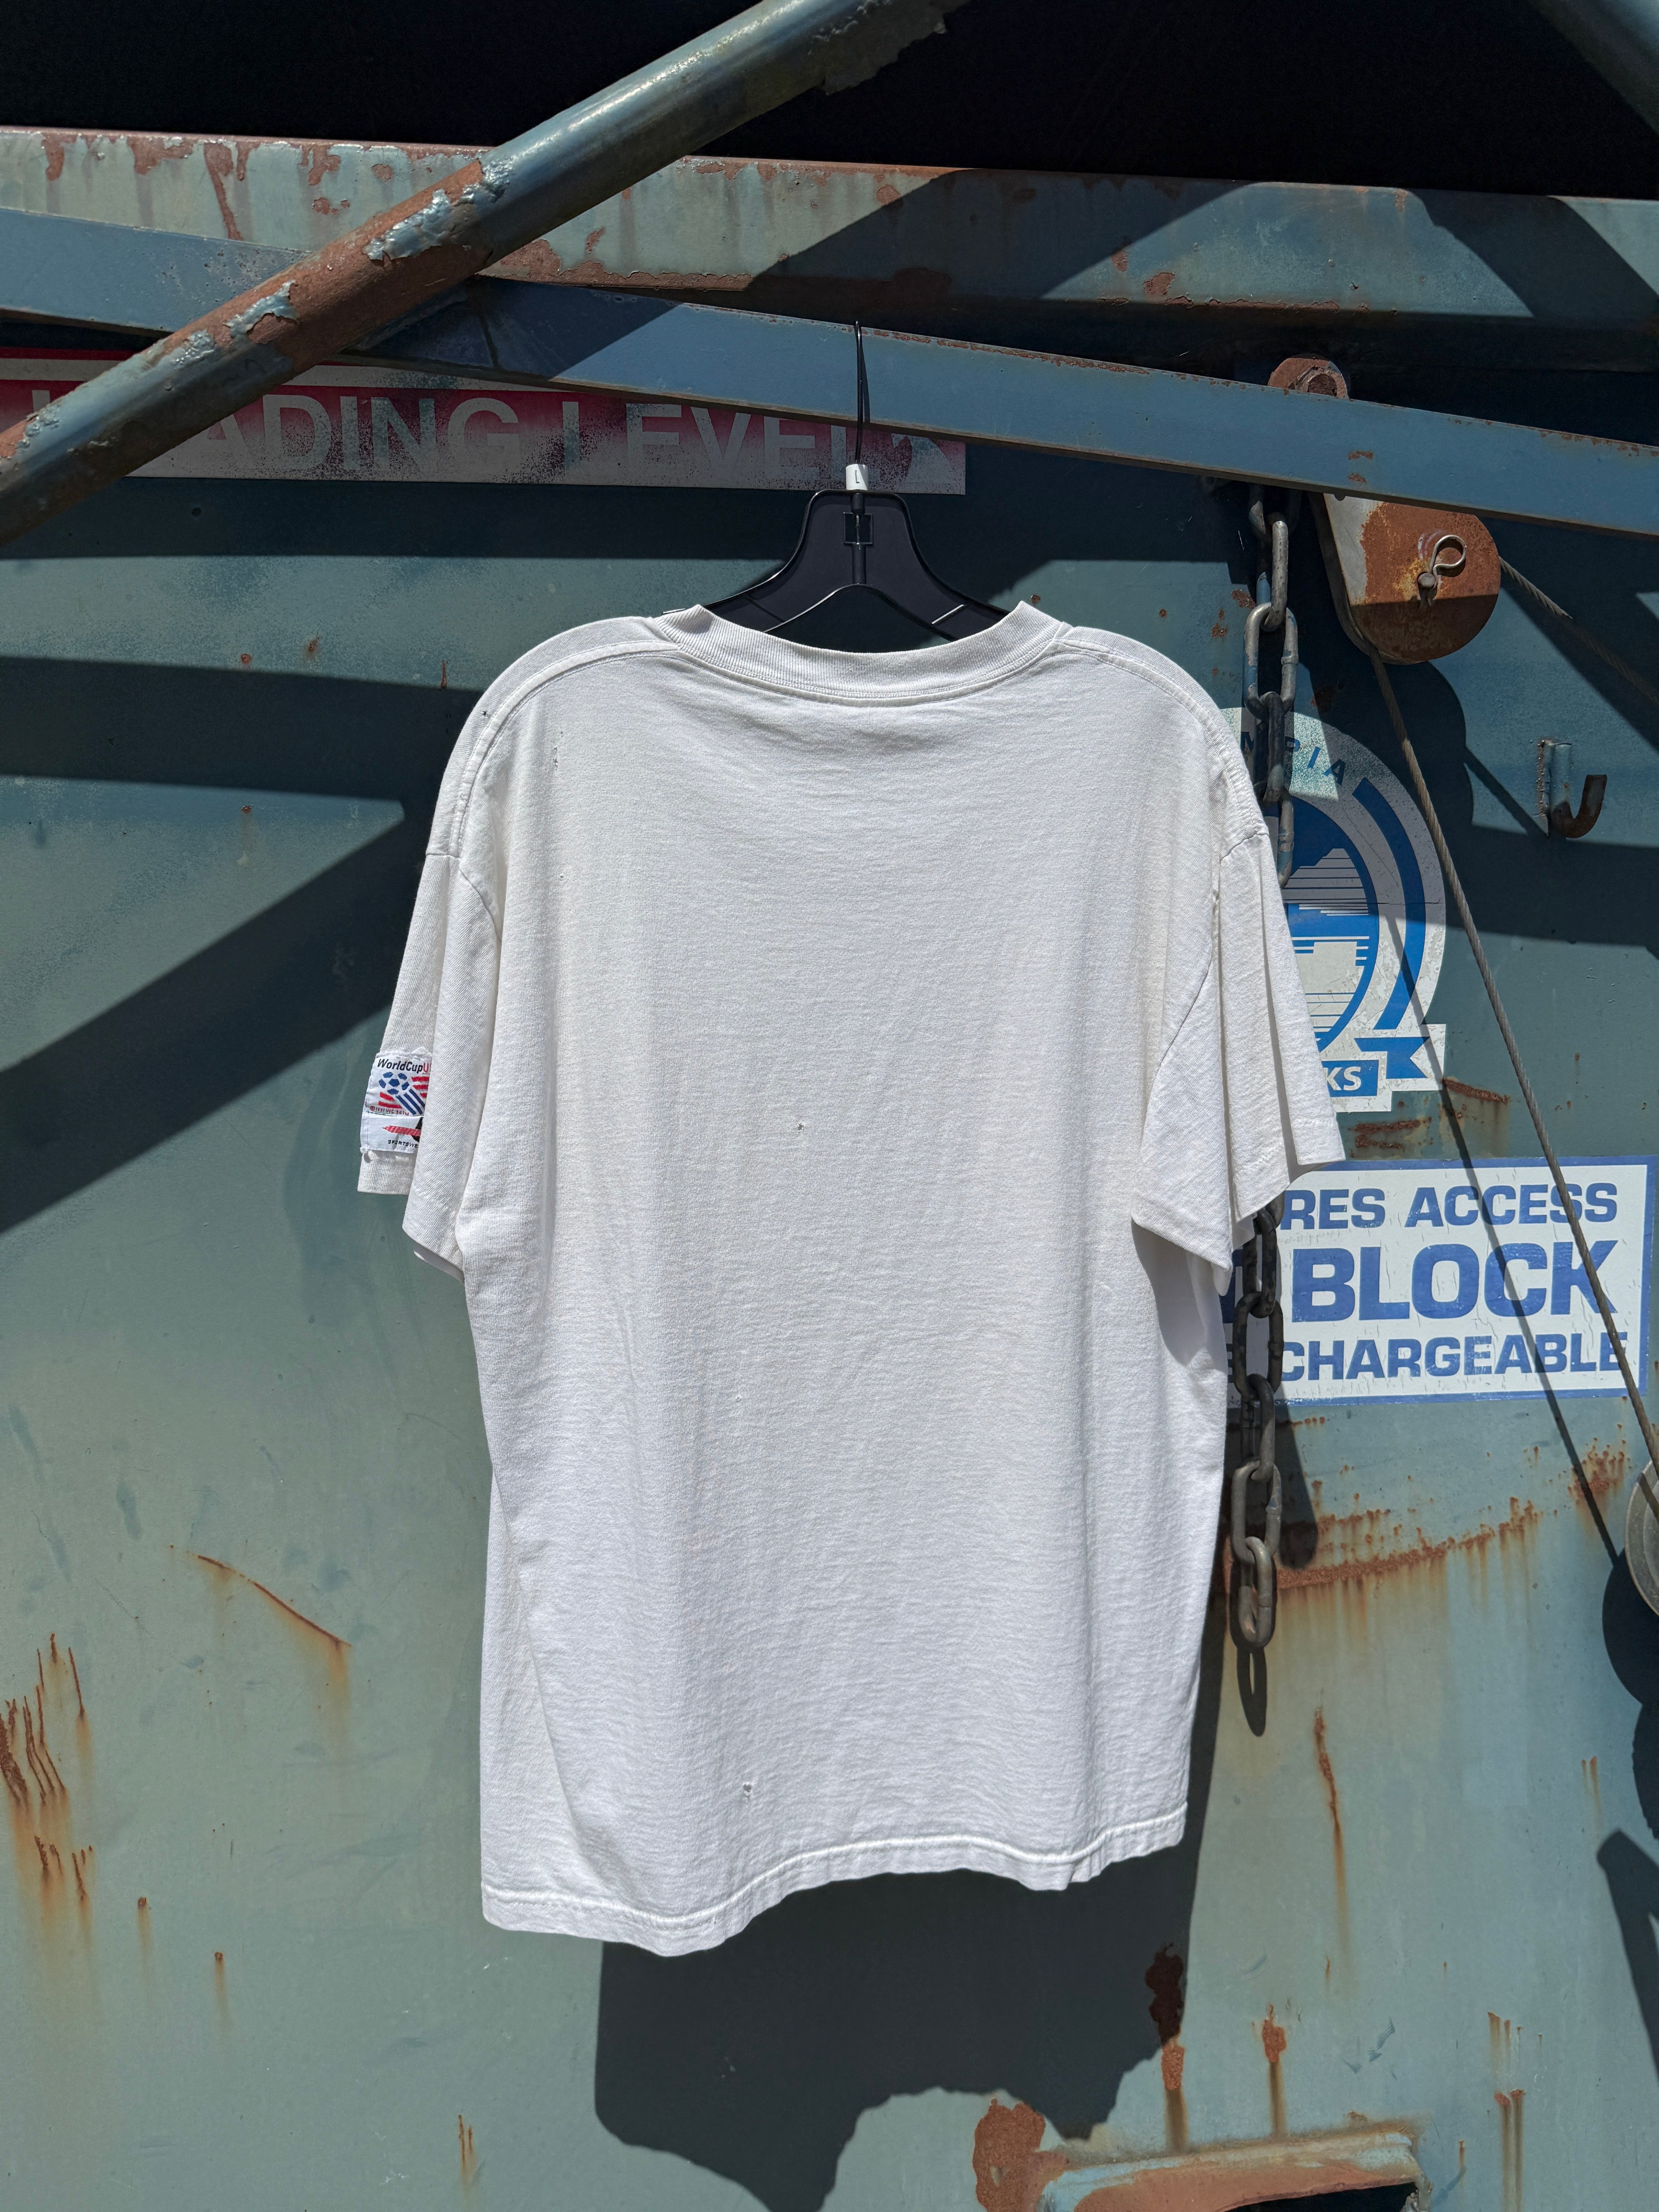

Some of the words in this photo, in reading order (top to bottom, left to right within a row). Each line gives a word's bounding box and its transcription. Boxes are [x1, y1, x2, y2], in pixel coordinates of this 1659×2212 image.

[1280, 1188, 1386, 1230] RES
[1404, 1182, 1618, 1228] ACCESS
[1291, 1240, 1619, 1322] BLOCK
[1281, 1331, 1628, 1382] CHARGEABLE
